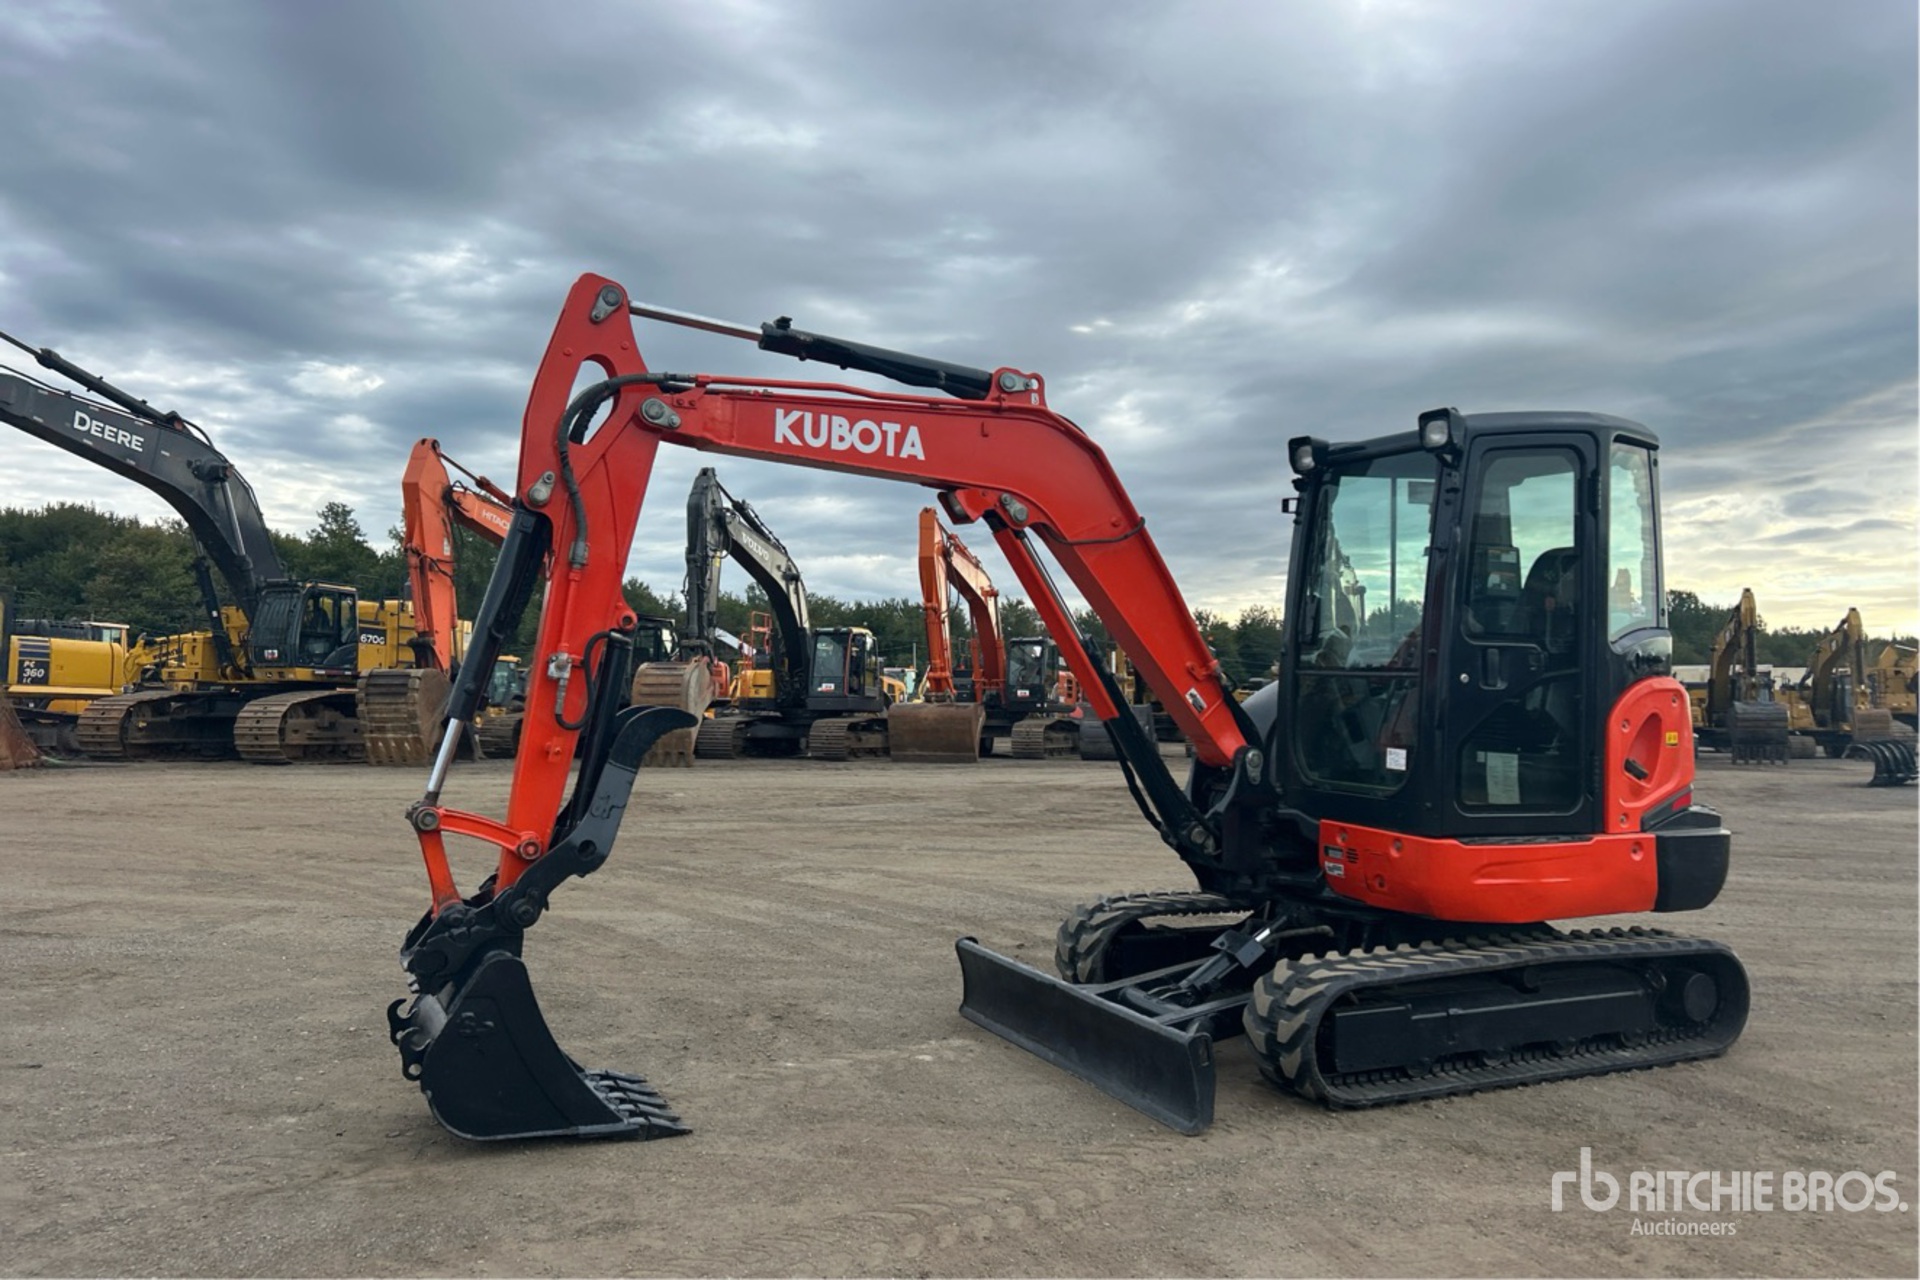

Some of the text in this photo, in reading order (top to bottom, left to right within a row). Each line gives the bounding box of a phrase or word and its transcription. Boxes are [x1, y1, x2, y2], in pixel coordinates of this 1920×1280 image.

[73, 410, 144, 452] DEERE
[774, 407, 926, 462] KUBOTA
[482, 508, 511, 530] HITAC
[741, 531, 770, 561] VOLVO
[360, 633, 385, 645] 670G
[22, 668, 45, 678] 360
